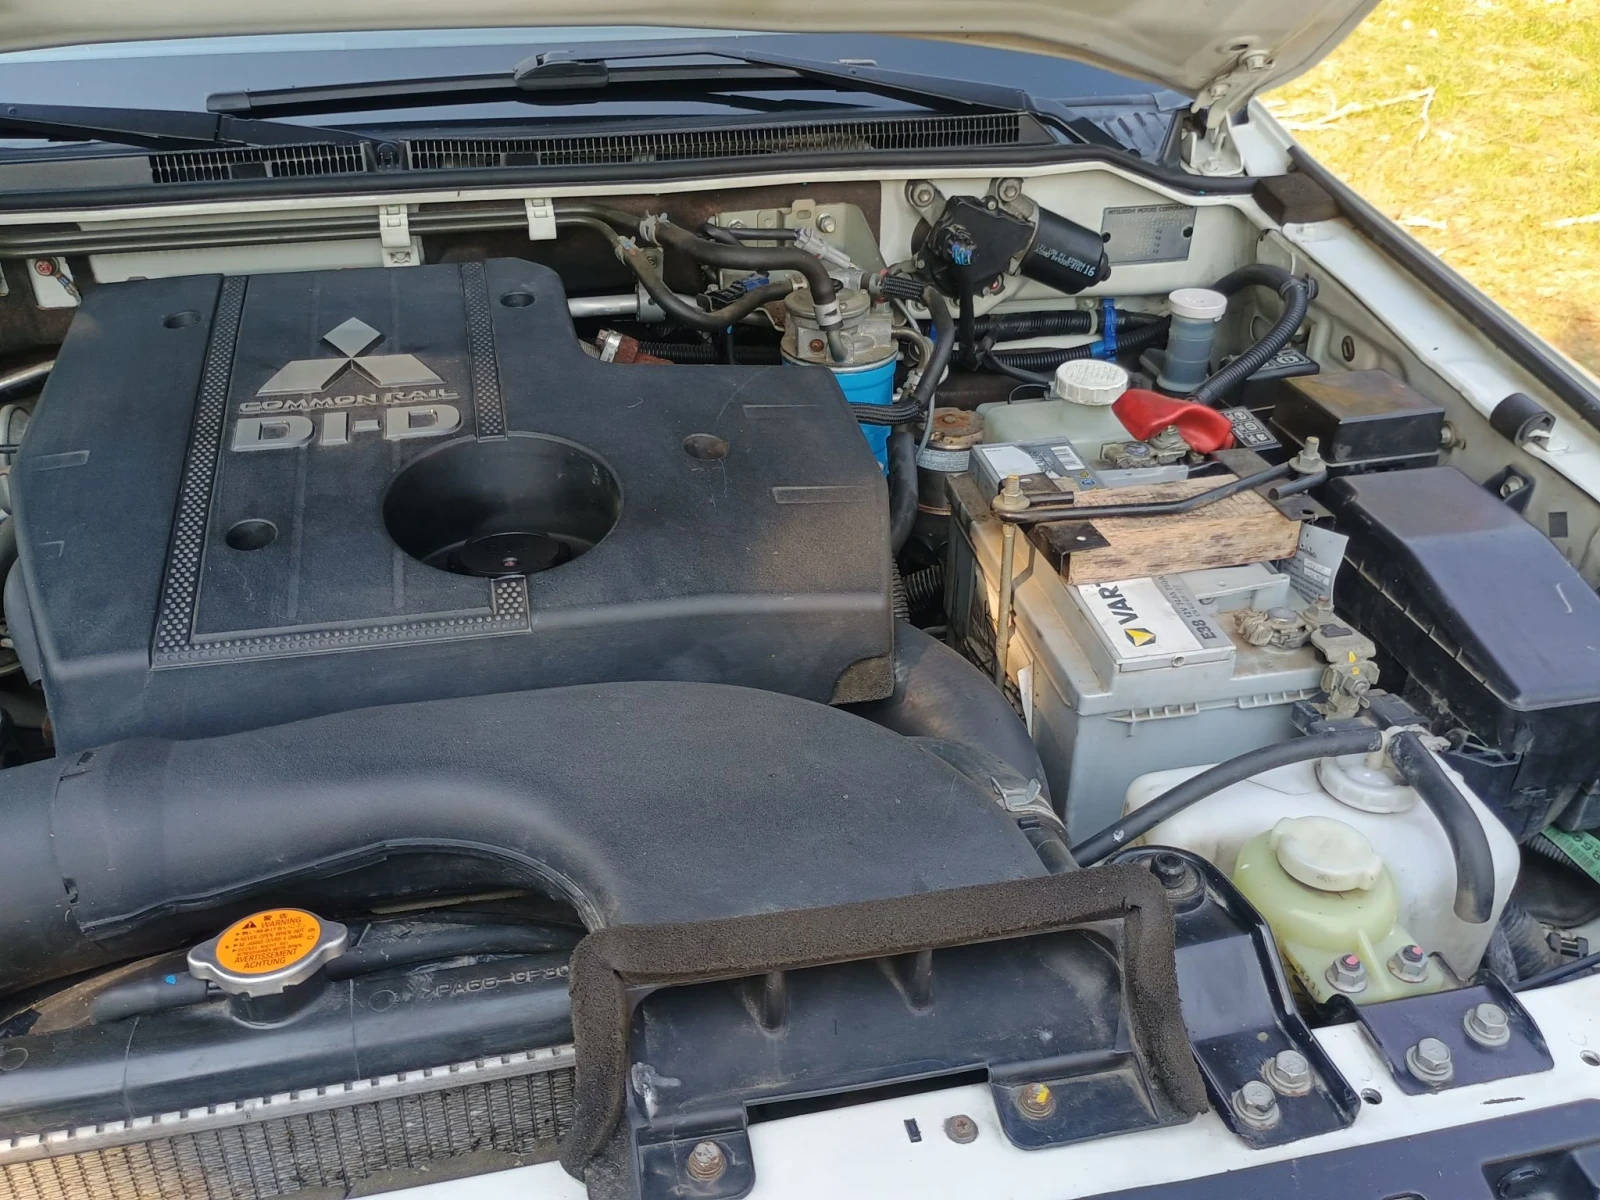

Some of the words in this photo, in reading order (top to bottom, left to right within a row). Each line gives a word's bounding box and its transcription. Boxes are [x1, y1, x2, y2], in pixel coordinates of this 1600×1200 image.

[1083, 264, 1097, 277] 16
[239, 393, 379, 415] COMMON
[384, 388, 461, 405] RAIL
[231, 404, 463, 453] DI-D
[1190, 619, 1218, 640] E38
[260, 916, 302, 929] WARNING
[234, 948, 298, 964] AVERTISSEMENT
[243, 957, 287, 969] ACHTUNG
